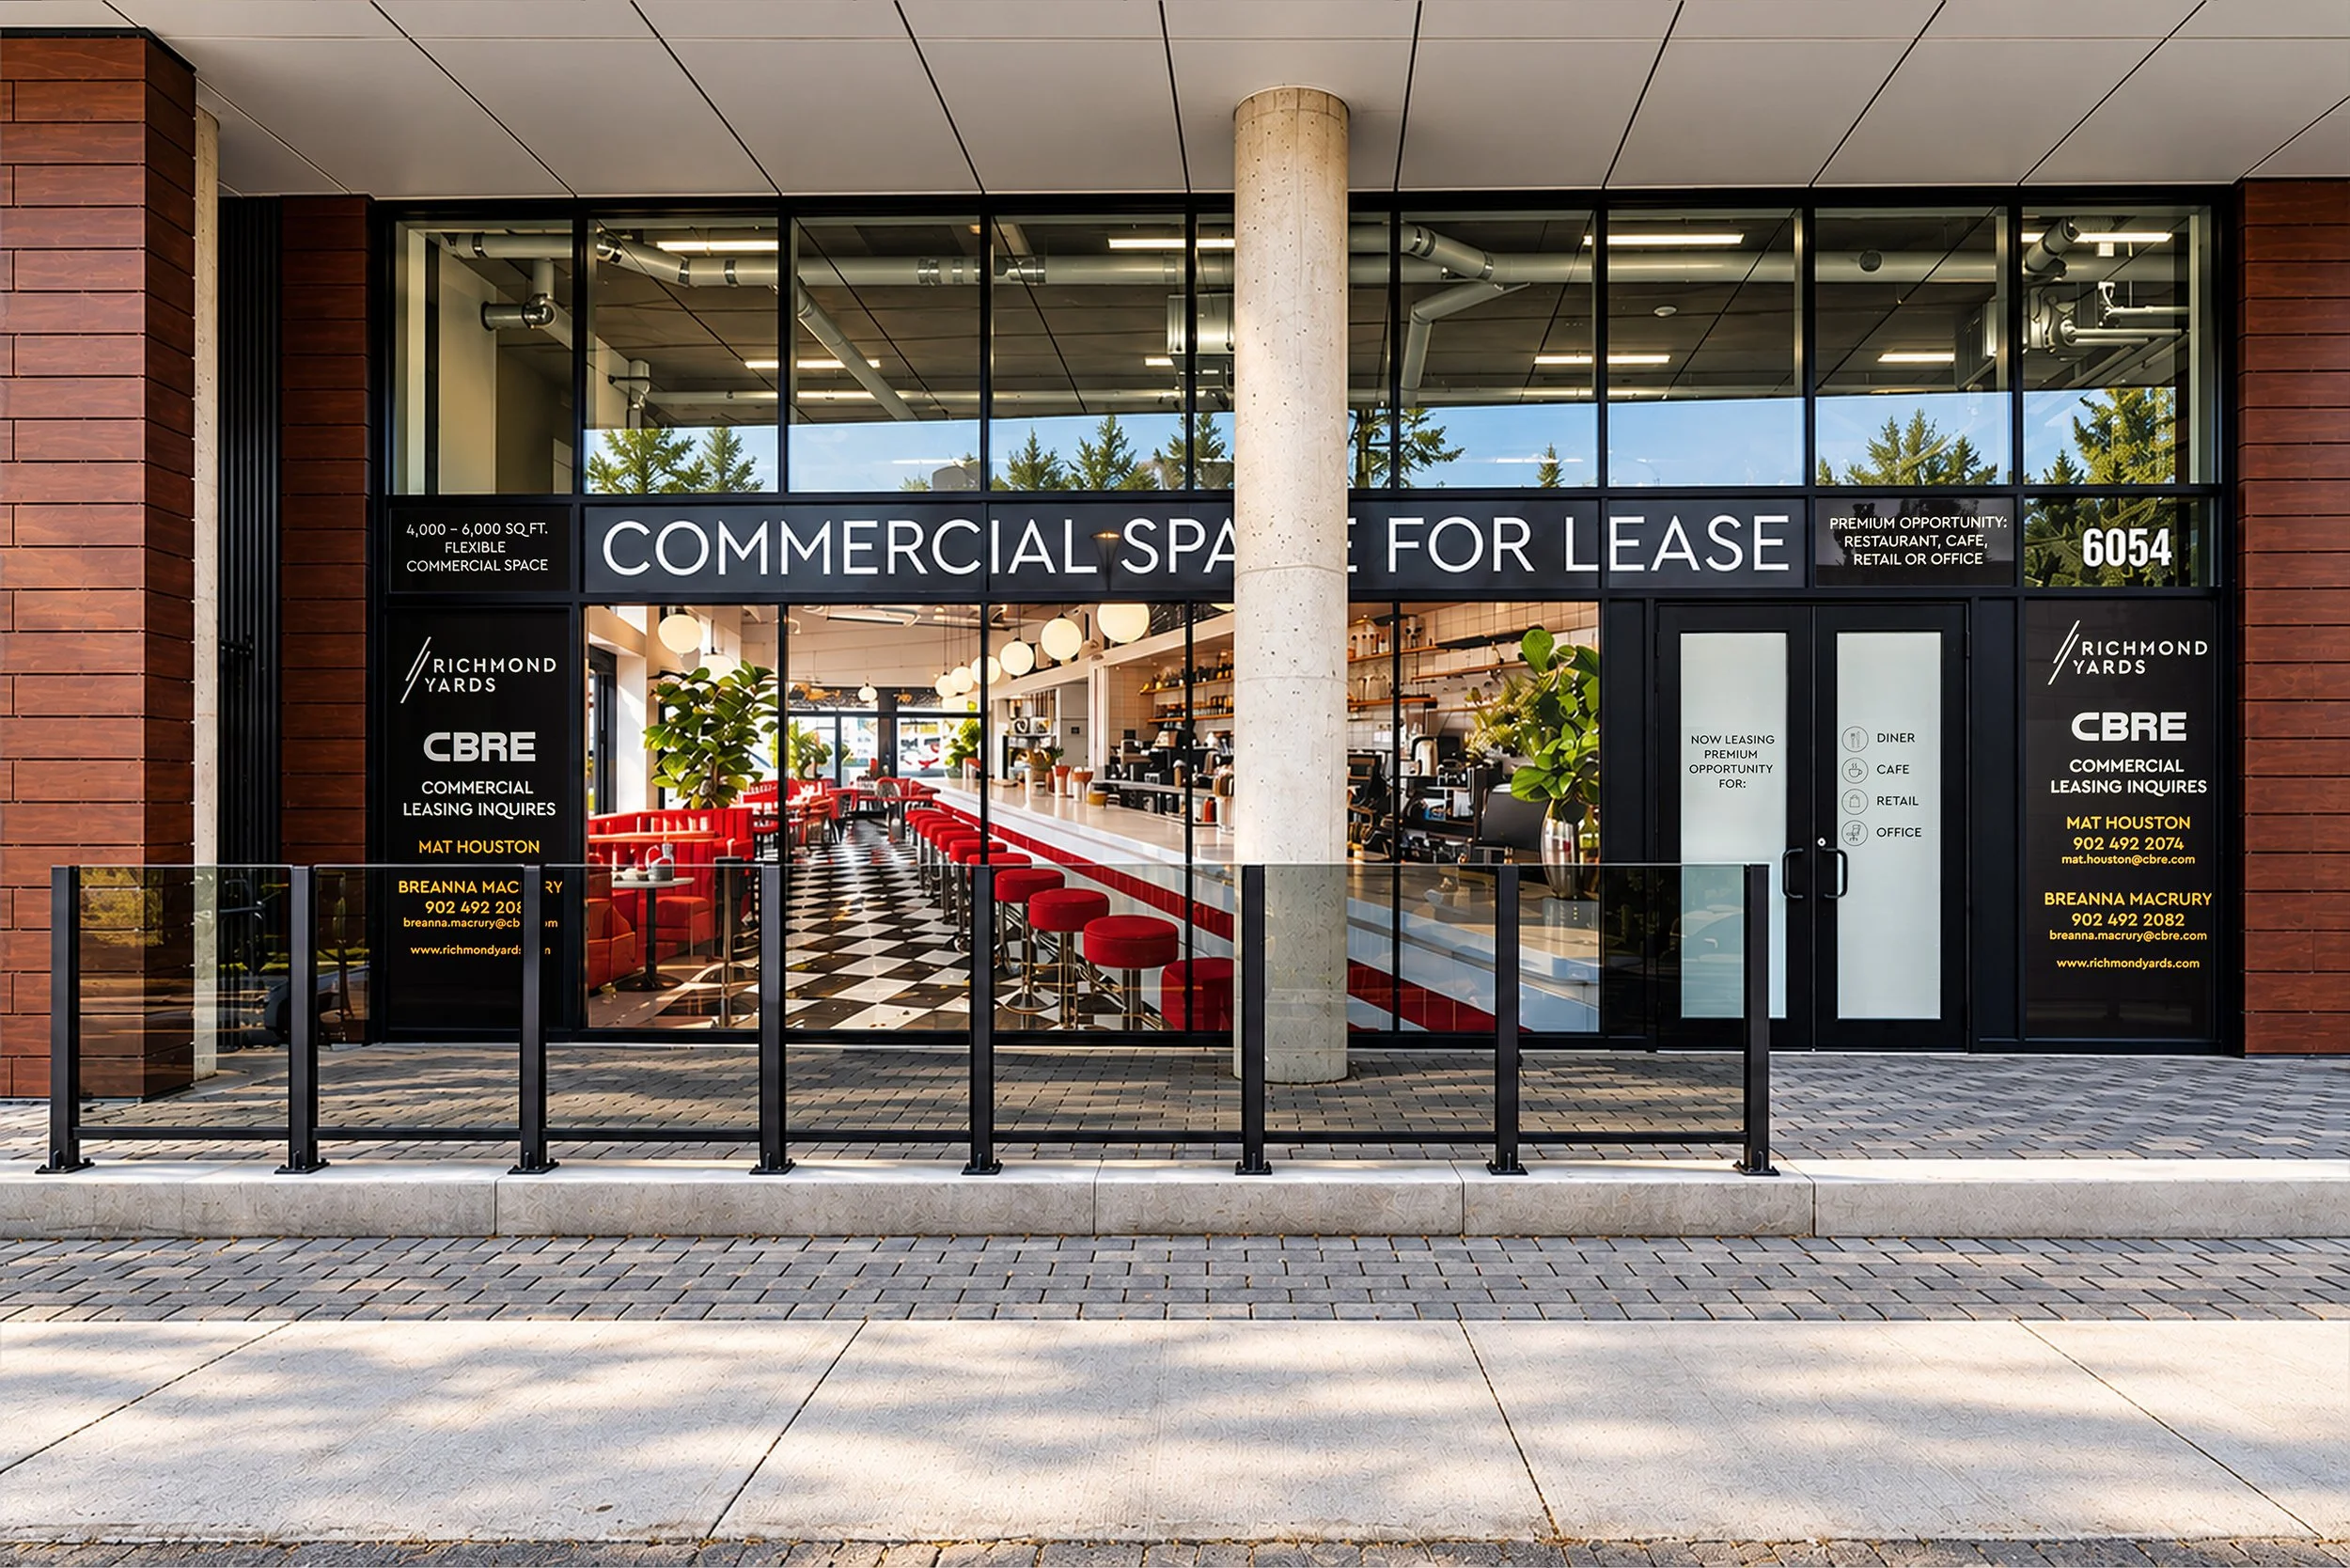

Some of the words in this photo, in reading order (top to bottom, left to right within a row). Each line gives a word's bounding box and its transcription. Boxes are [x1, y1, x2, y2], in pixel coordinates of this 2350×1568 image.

[1829, 516, 1895, 530] PREMIUM
[1899, 515, 2008, 529] OPPORTUNITY:
[406, 523, 446, 539] 4,000
[462, 522, 501, 538] 6,000
[445, 541, 507, 554] FLEXIBLE
[603, 518, 1098, 576] COMMERCIAL
[1121, 517, 1358, 574] SPA
[1387, 516, 1535, 573] FOR
[1565, 514, 1790, 572] LEASE
[1844, 534, 1942, 550] RESTAURANT,
[1945, 533, 1988, 550] CAFE,
[2081, 527, 2172, 568] 6054
[406, 558, 502, 572] COMMERCIAL
[504, 557, 549, 572] SPACE
[1853, 553, 1903, 566] RETAIL
[1904, 552, 1927, 566] OR
[1930, 551, 1983, 565] OFFICE
[2081, 640, 2208, 656] RICHMOND
[433, 657, 556, 674] RICHMOND
[2072, 659, 2146, 675] YARDS
[425, 677, 496, 693] YARDS
[2071, 712, 2187, 742] CBRE
[1691, 734, 1722, 745] NOW
[1725, 734, 1775, 745] LEASING
[1877, 732, 1916, 744] DINER
[423, 731, 537, 762] CBRE
[1704, 749, 1758, 760] PREMIUM
[1688, 763, 1774, 775] OPPORTUNITY
[1876, 763, 1910, 775] CAFE
[2069, 759, 2185, 774] COMMERCIAL
[421, 780, 534, 795] COMMERCIAL
[1718, 778, 1747, 789] FOR:
[2050, 779, 2123, 794] LEASING
[2127, 779, 2208, 797] INQUIRES
[1876, 795, 1919, 807] RETAIL
[403, 802, 474, 817] LEASING
[478, 802, 556, 821] INQUIRES
[2066, 815, 2103, 830] MAT
[2106, 815, 2191, 830] HOUSTON
[1876, 827, 1922, 838] OFFICE
[418, 839, 453, 855] MAT
[457, 839, 540, 855] HOUSTON
[2073, 836, 2105, 851] 902
[2108, 836, 2140, 851] 492
[2144, 836, 2185, 851] 2074
[2061, 853, 2196, 867] mat.houston@cbre.com
[398, 880, 478, 894] BREANNA
[482, 880, 563, 894] MACRY
[2044, 891, 2126, 906] BREANNA
[2129, 891, 2213, 906] MACRURY
[425, 900, 456, 915] 902
[460, 901, 491, 915] 492
[403, 917, 558, 930] breanna.macrury@cbm
[2071, 912, 2103, 927] 902
[2107, 912, 2138, 927] 492
[2142, 912, 2186, 927] 2082
[2049, 929, 2208, 943] breanna.macrury@cbre.com
[2056, 957, 2201, 970] www.richmondyards.com
